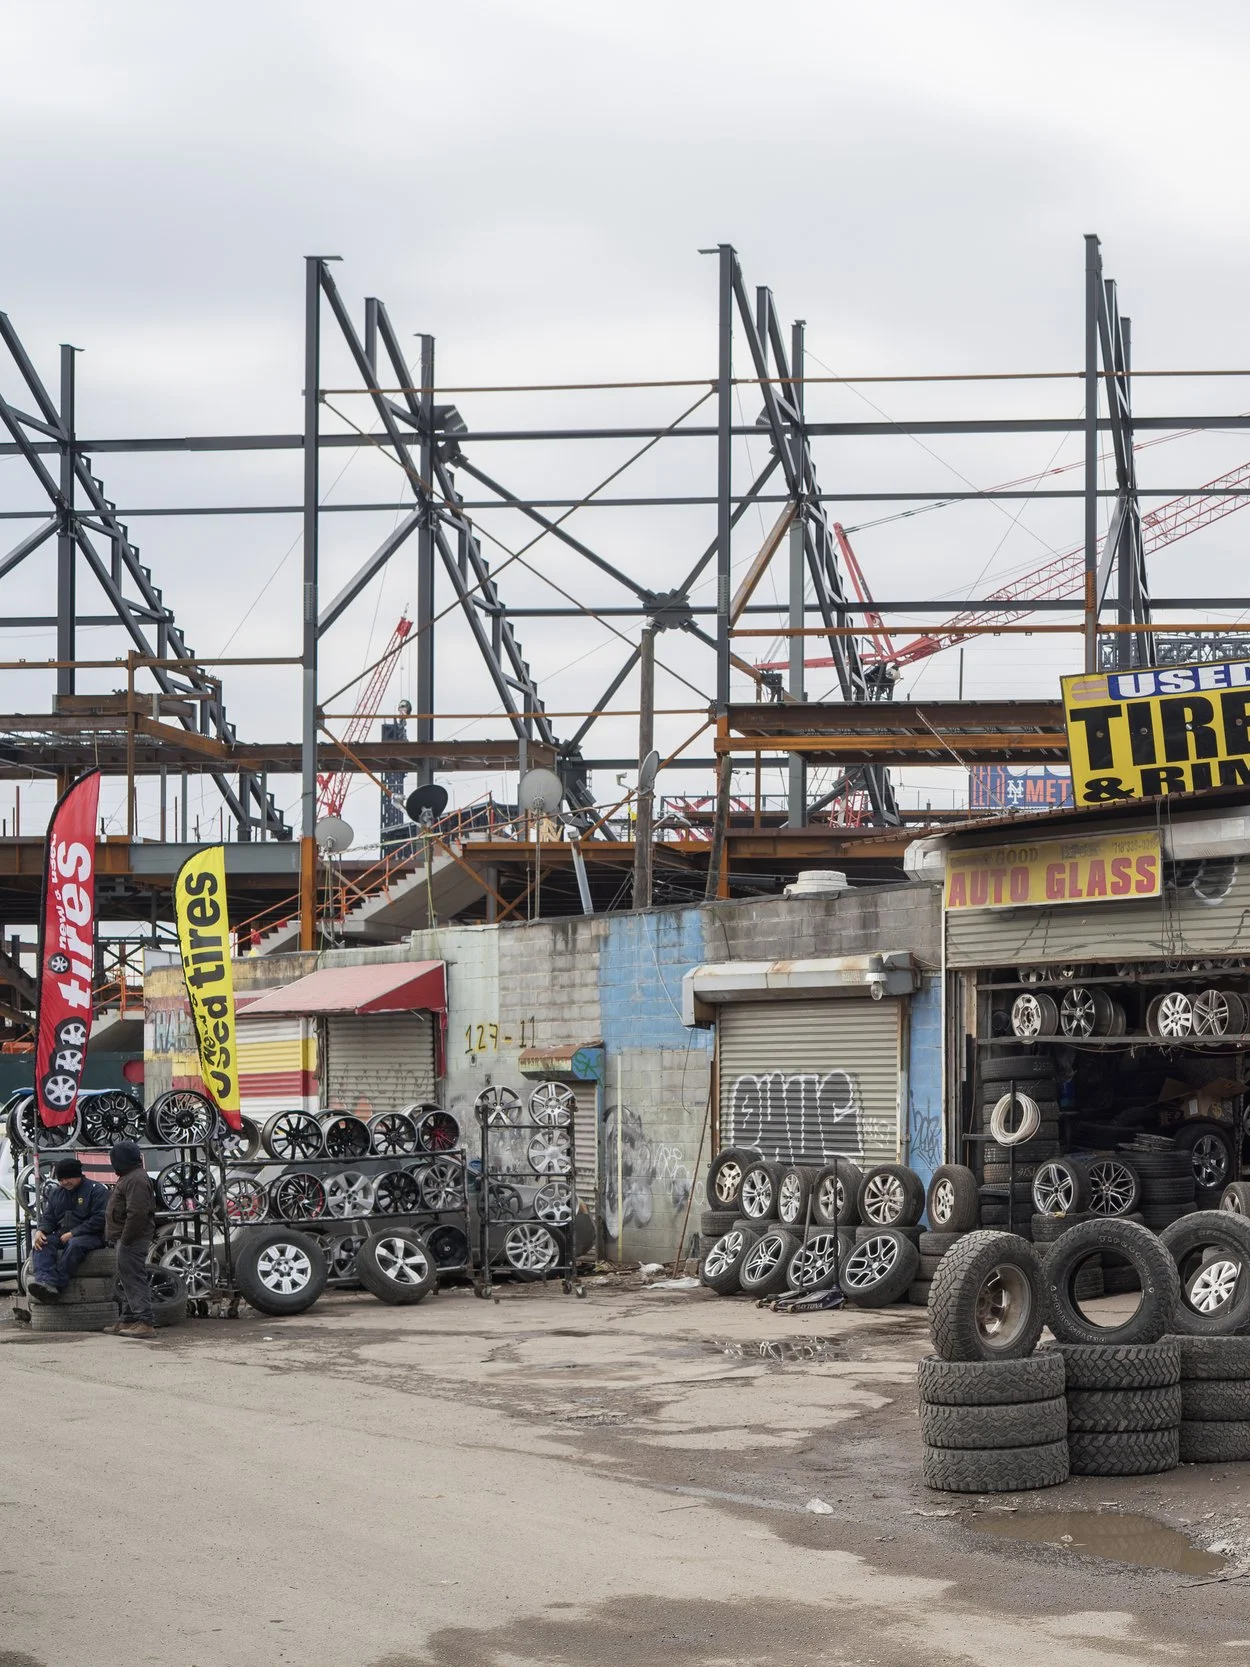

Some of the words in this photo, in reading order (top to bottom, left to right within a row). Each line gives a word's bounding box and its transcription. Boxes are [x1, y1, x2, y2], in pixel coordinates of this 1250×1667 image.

[1025, 778, 1074, 803] MET
[1083, 776, 1135, 803] &
[948, 866, 1030, 907] AUTO
[1045, 854, 1157, 900] GLASS
[56, 840, 93, 1010] tires
[184, 871, 226, 990] tires
